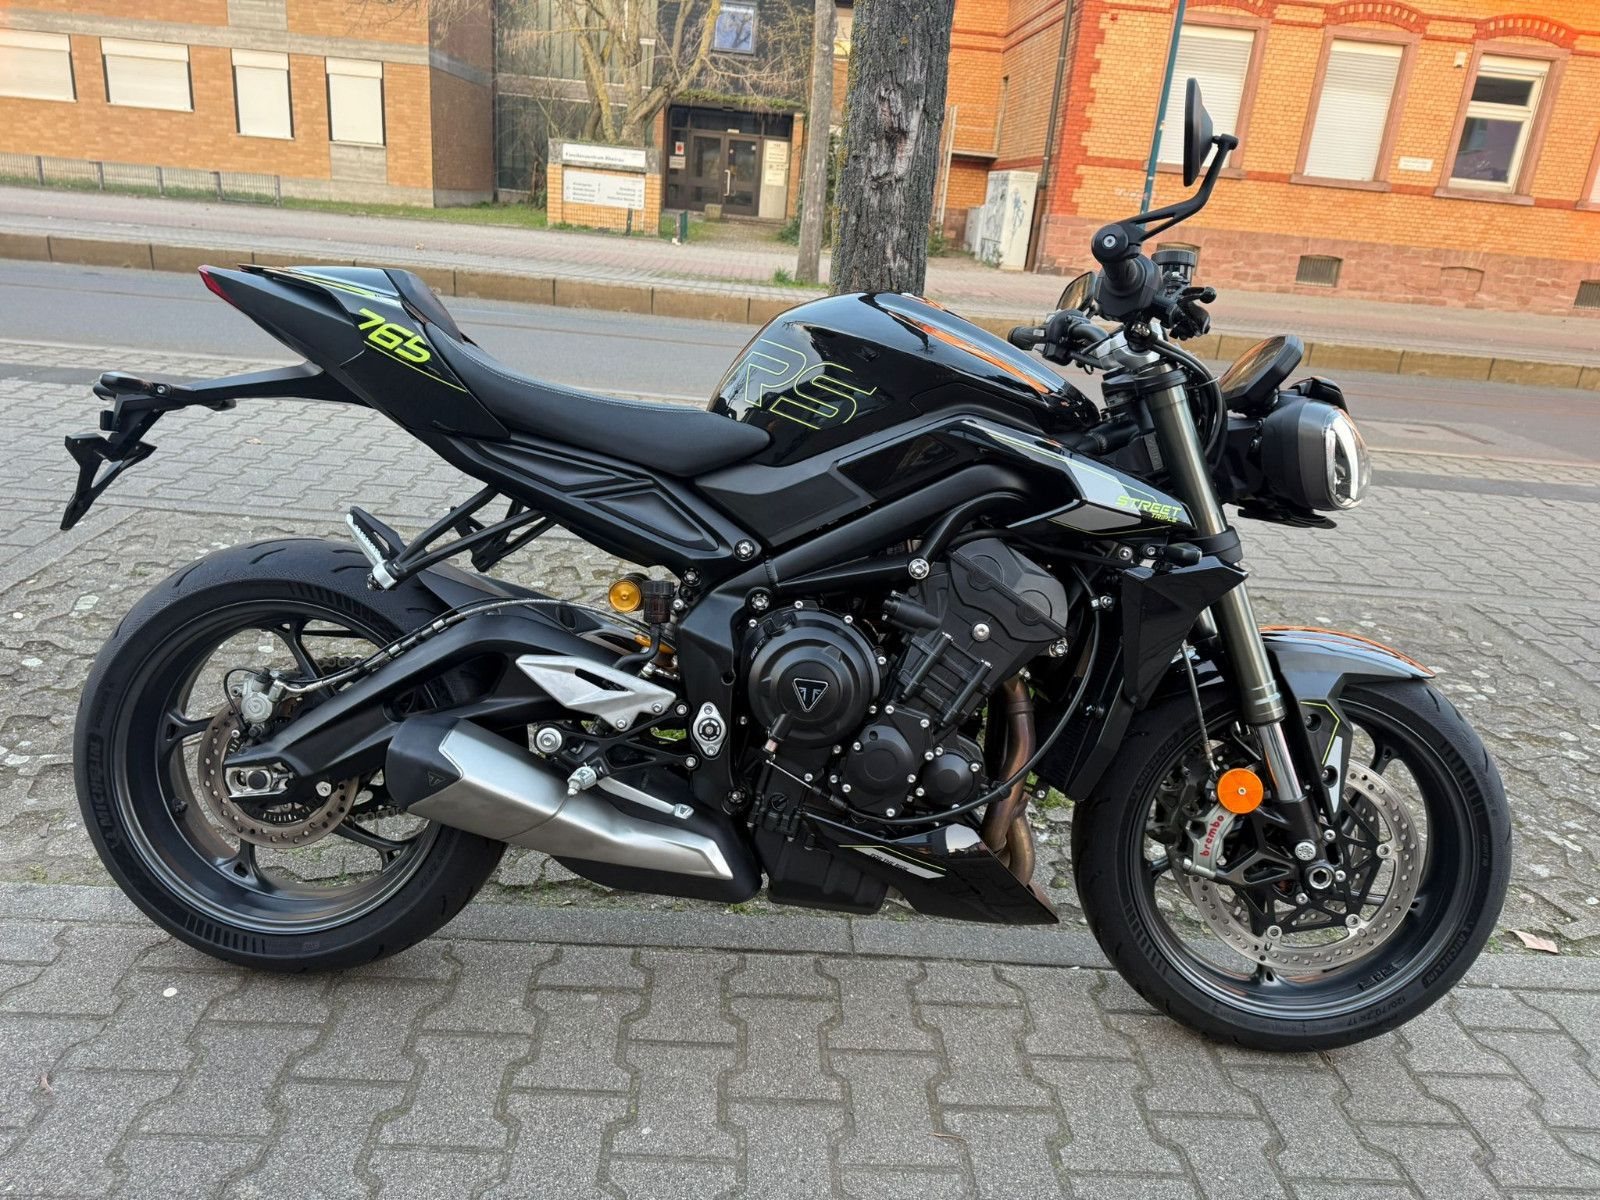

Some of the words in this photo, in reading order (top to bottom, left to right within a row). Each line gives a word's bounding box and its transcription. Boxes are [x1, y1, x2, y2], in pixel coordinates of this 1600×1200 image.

[358, 307, 431, 363] 765
[721, 338, 878, 430] RS
[1116, 495, 1182, 517] STREET
[1200, 815, 1225, 857] brembo
